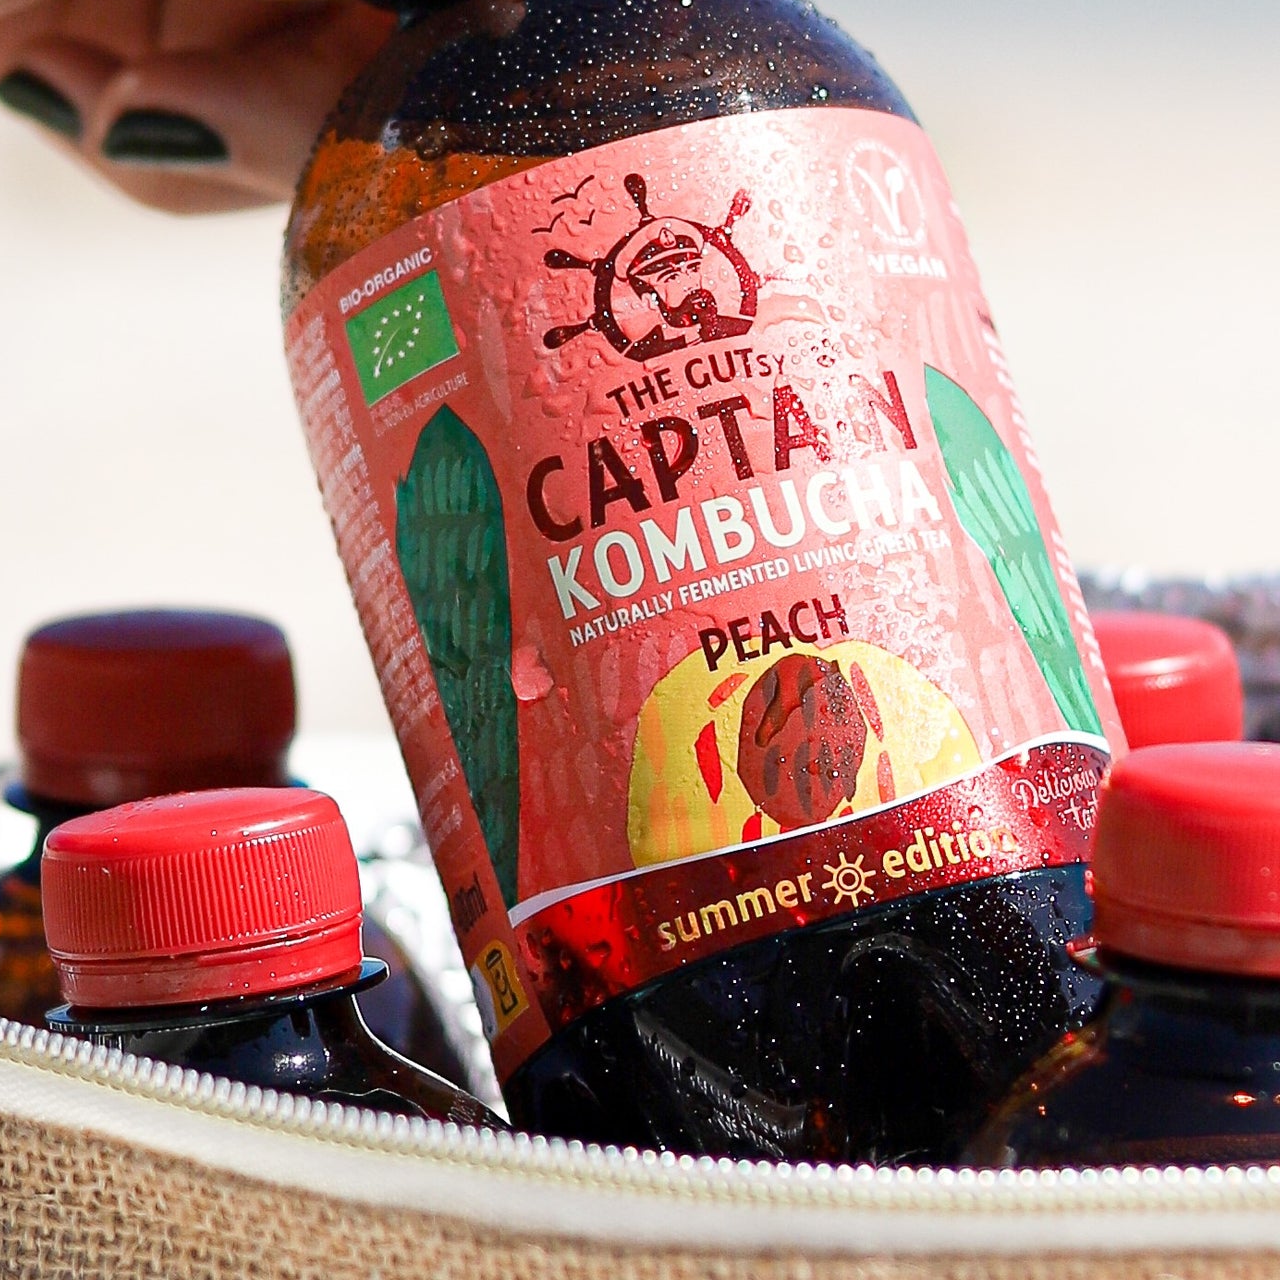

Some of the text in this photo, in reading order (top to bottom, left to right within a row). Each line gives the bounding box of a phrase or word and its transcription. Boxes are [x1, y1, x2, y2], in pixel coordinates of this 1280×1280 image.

[339, 247, 433, 313] BIO-ORGANIC
[867, 253, 949, 279] VEGAN
[606, 368, 678, 418] THE
[525, 370, 918, 542] CAPTAN
[547, 460, 944, 619] KOMBUCHA
[569, 529, 952, 647] NATURALLY FERMENTED LIVING GREEN TEA
[698, 593, 850, 672] PEACH
[1011, 767, 1098, 810] Delicious
[656, 819, 1019, 951] summer edition
